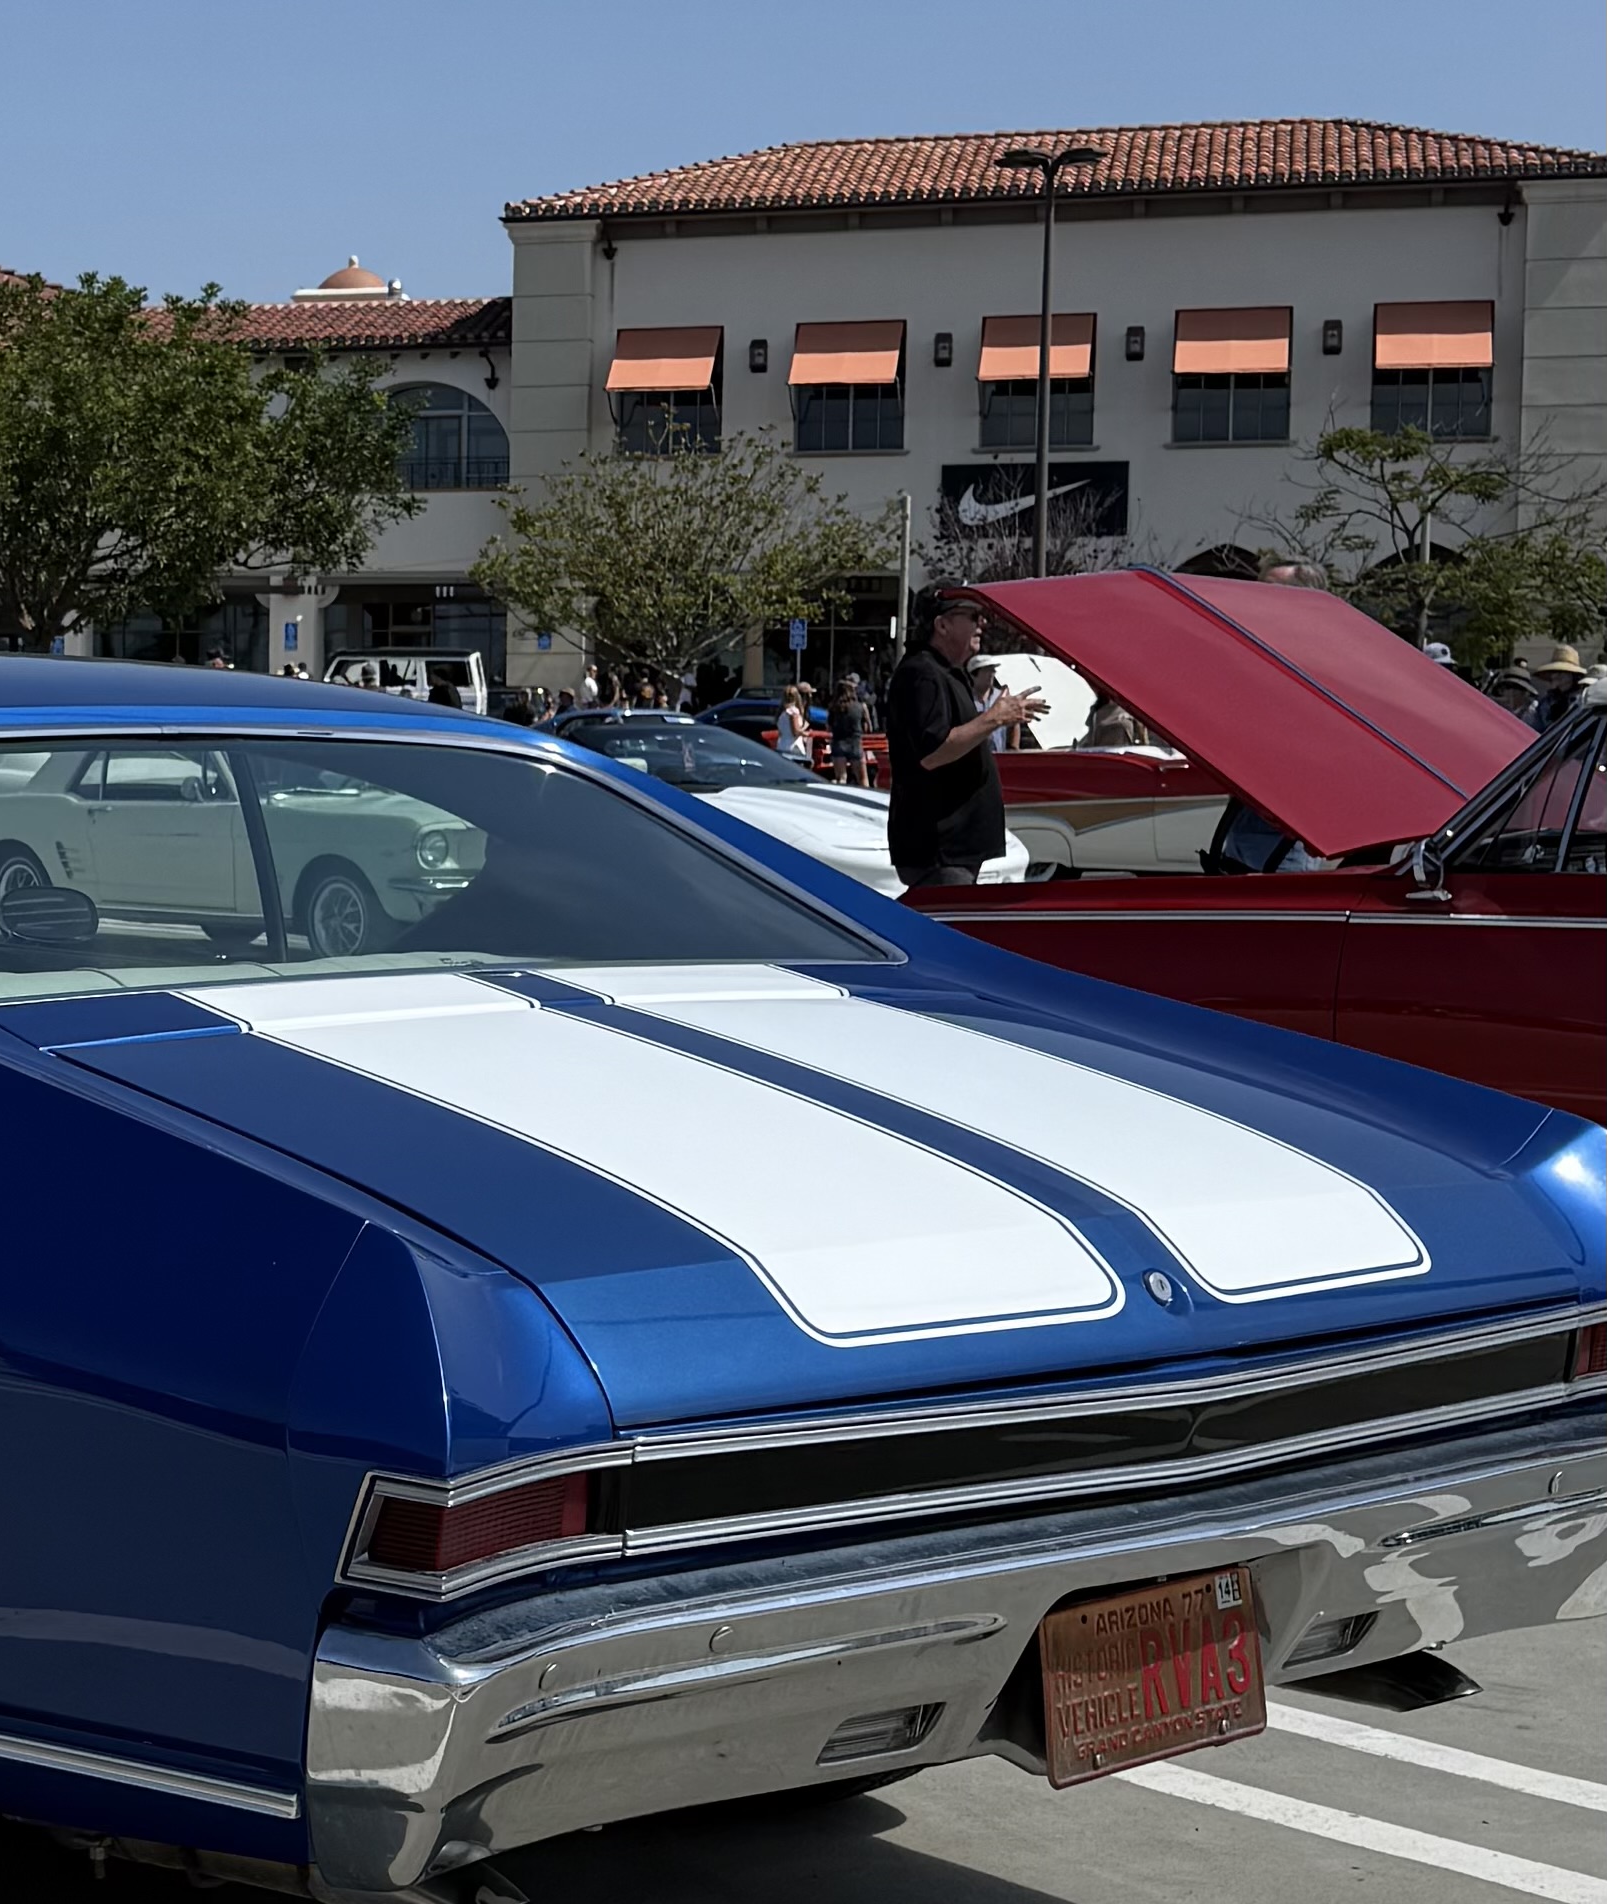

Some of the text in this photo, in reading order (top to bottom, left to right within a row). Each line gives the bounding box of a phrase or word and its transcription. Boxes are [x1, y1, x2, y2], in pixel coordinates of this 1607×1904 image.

[1095, 1588, 1205, 1636] ARIZONA 77
[1217, 1580, 1230, 1600] 14
[1054, 1636, 1137, 1696] HISTORIC
[1139, 1611, 1252, 1720] RVA3
[1056, 1682, 1142, 1740] VEHICLE
[1078, 1698, 1243, 1760] GRAND CANYON STATE
